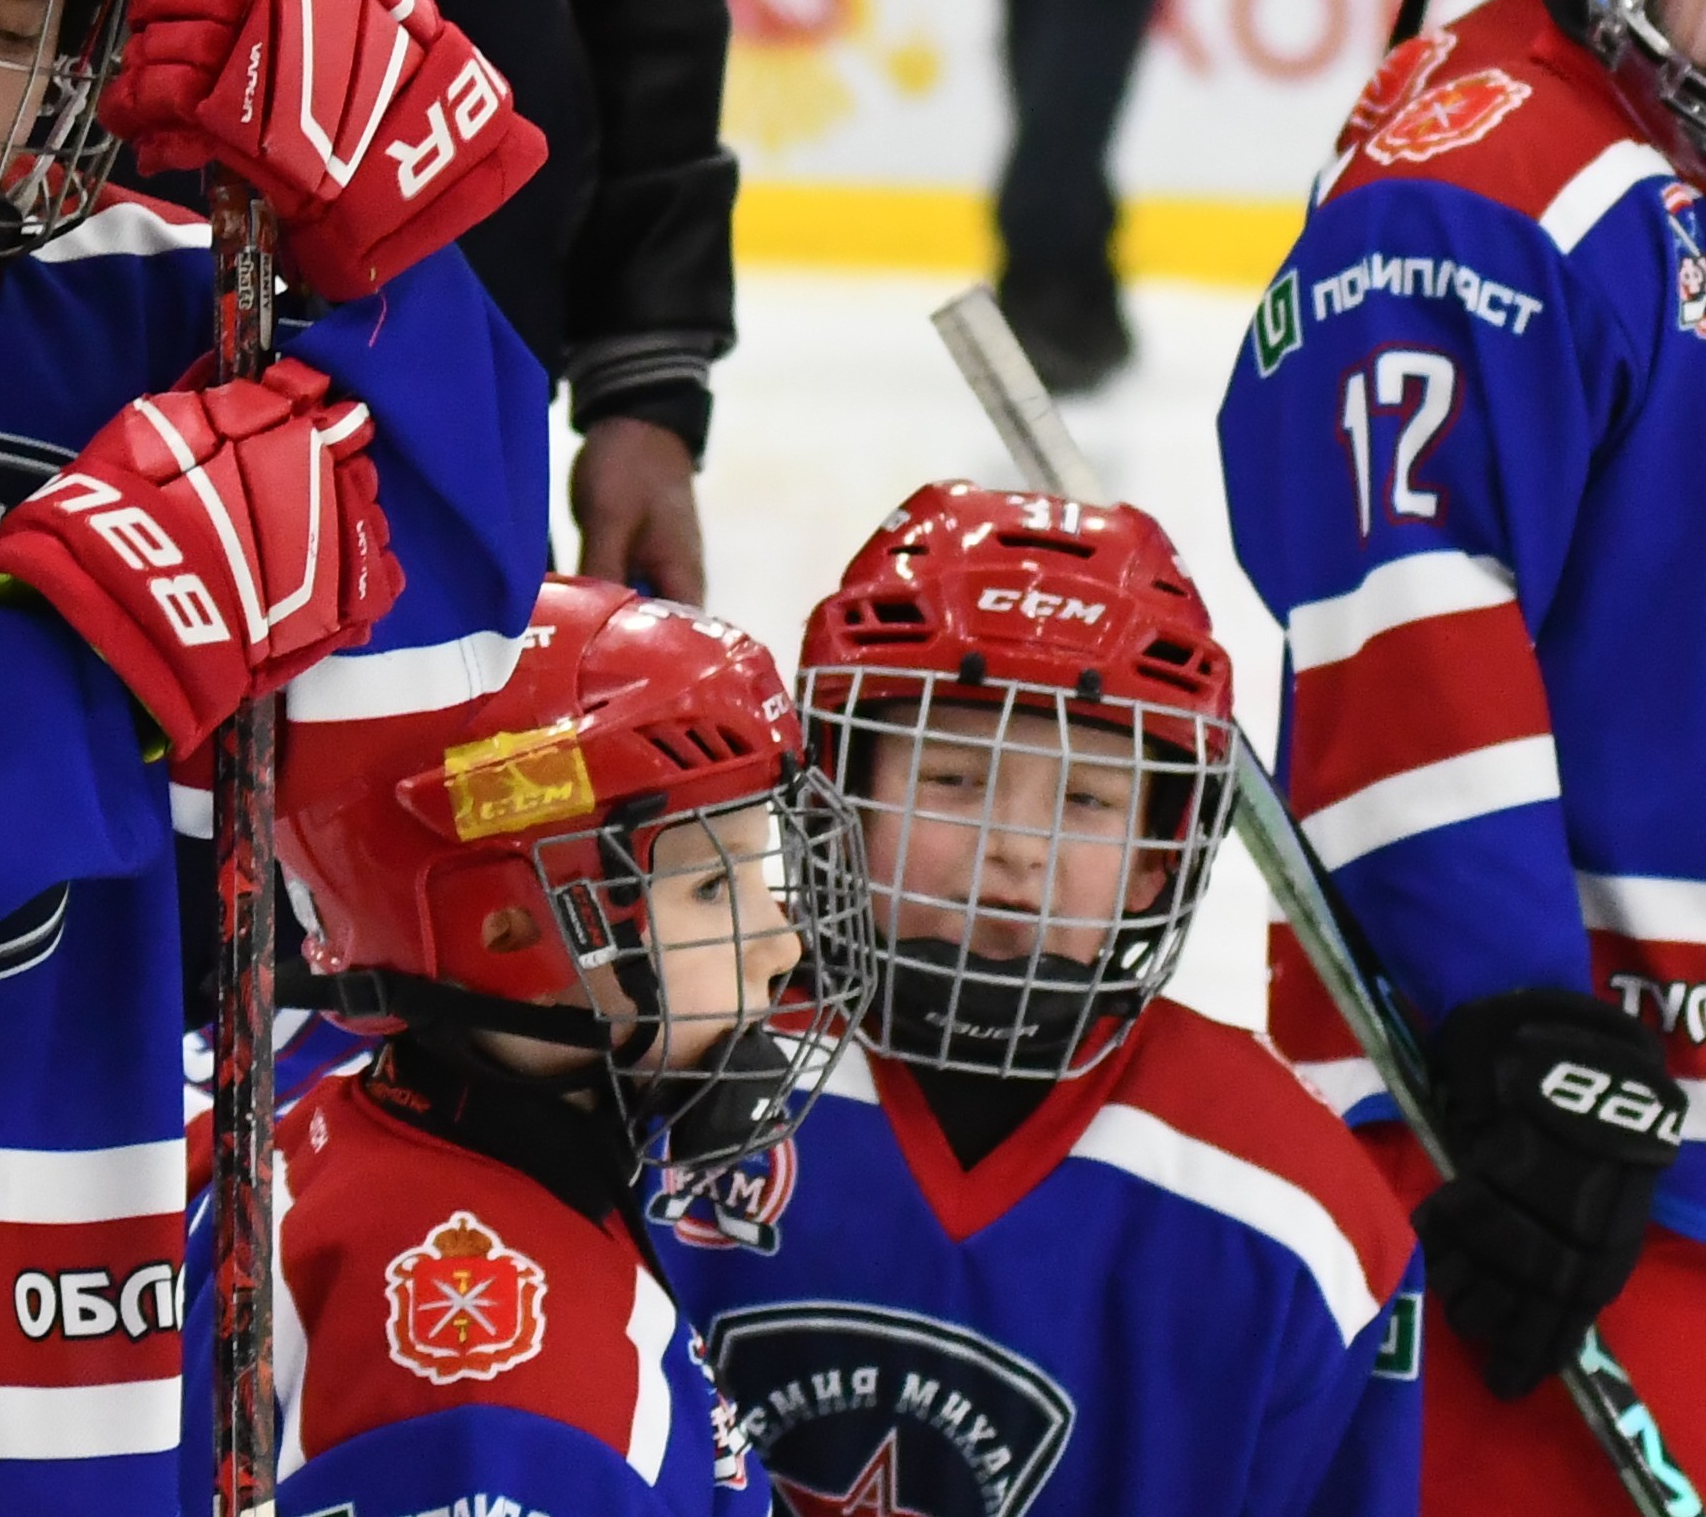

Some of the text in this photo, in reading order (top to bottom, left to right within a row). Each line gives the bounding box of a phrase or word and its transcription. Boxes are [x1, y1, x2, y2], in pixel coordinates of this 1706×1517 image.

[384, 44, 507, 200] ER
[1342, 348, 1455, 538] 12
[1022, 498, 1081, 535] 31
[977, 587, 1106, 625] CCM
